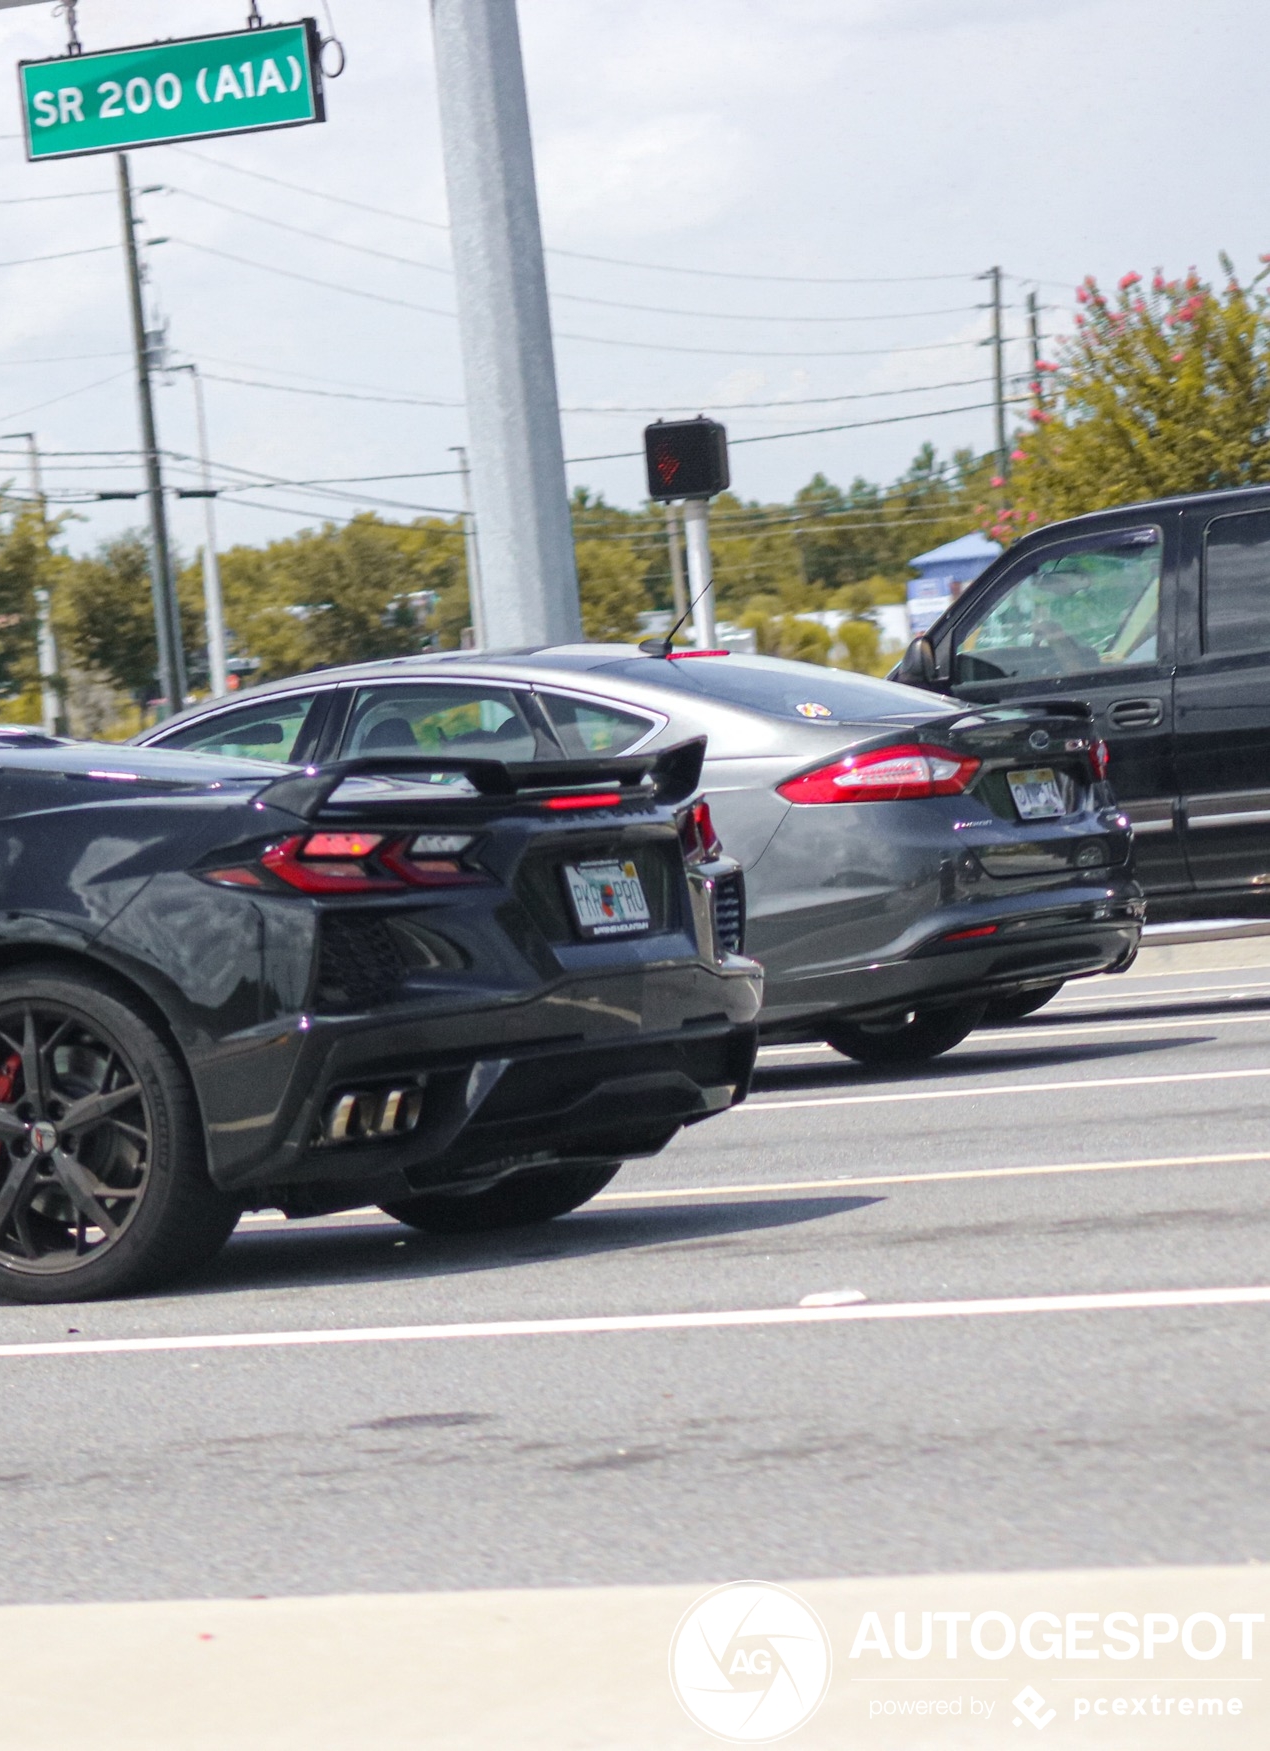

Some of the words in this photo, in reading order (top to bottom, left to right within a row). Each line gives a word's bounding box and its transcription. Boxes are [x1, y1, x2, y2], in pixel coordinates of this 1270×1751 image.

[33, 86, 85, 128] SR
[96, 72, 183, 119] 200
[195, 55, 303, 104] (A1A)
[613, 880, 645, 913] PRO
